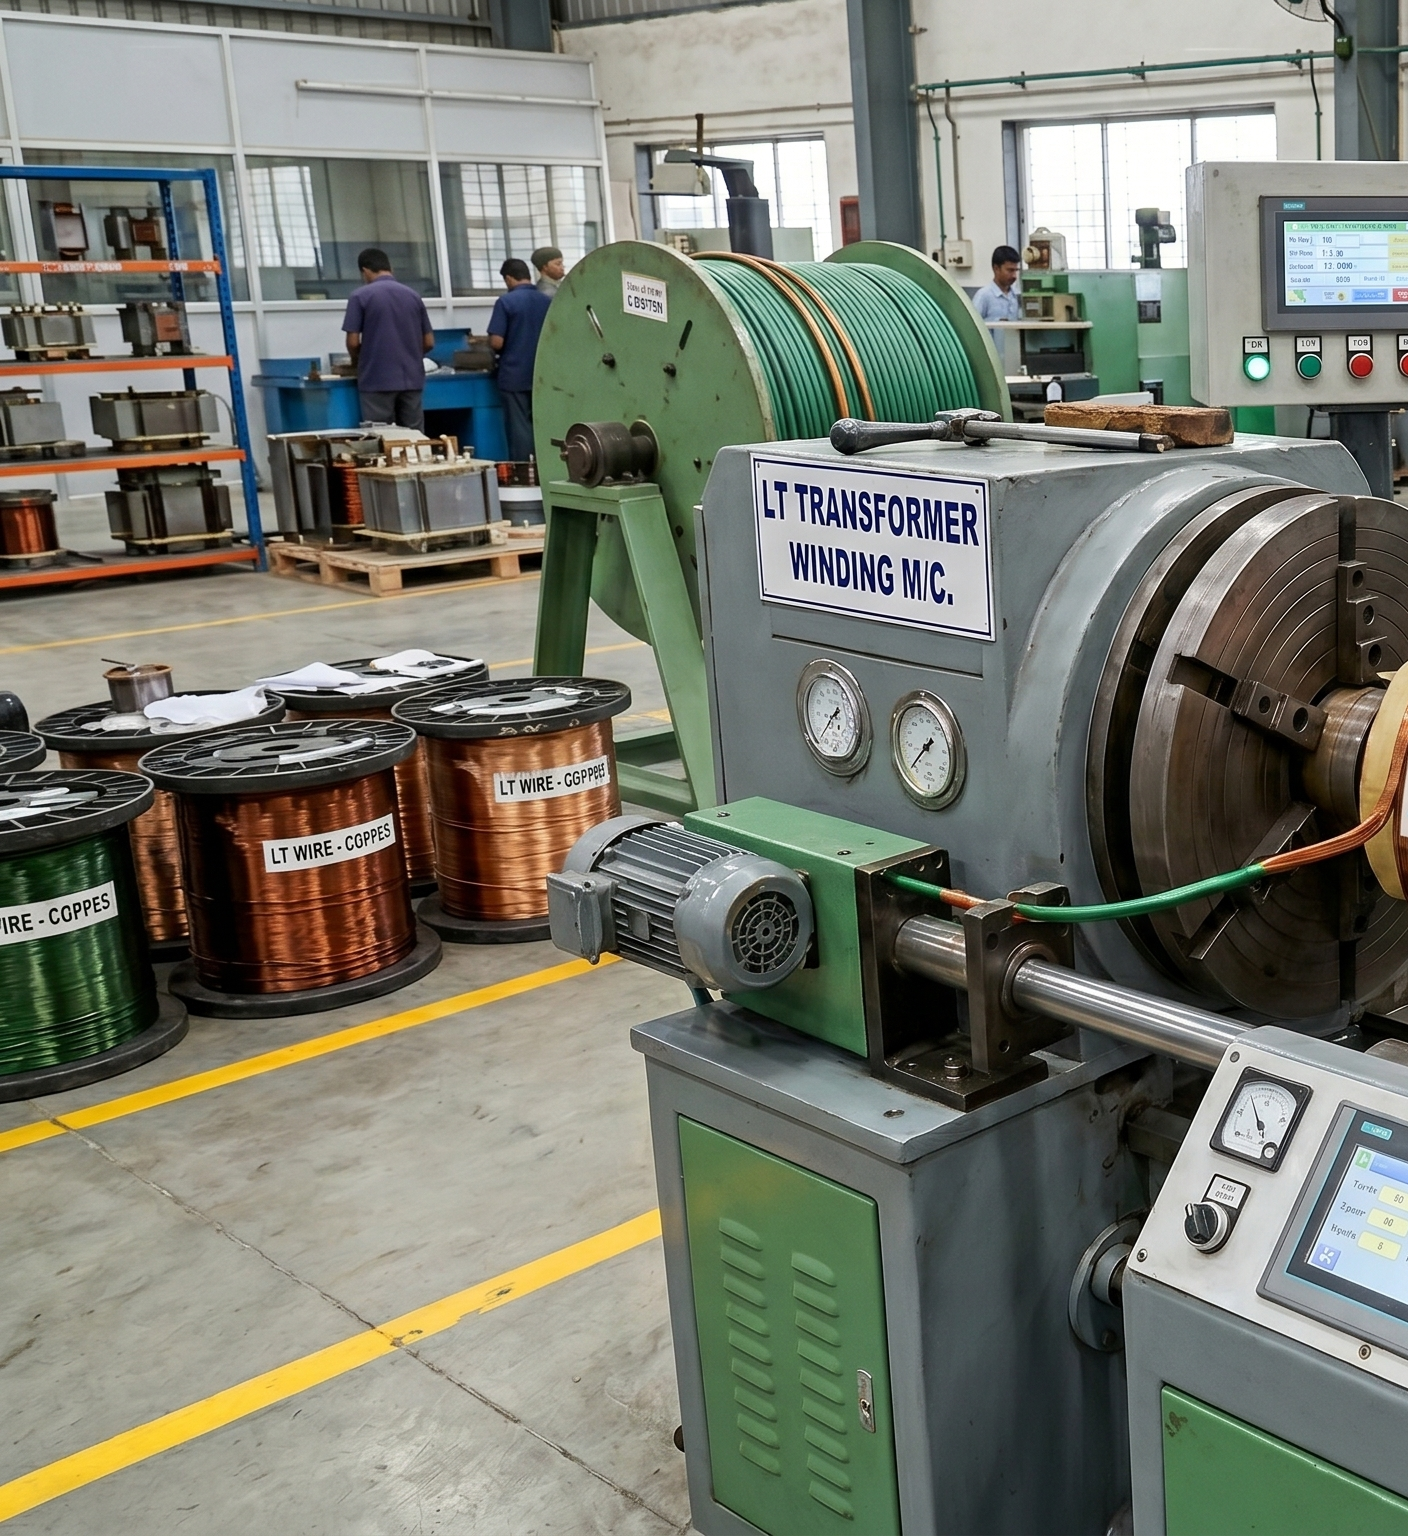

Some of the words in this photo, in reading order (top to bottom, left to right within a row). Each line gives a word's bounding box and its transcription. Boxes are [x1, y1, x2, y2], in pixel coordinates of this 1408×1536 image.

[762, 479, 788, 520] LT
[794, 482, 980, 546] TRANSFORMER
[789, 541, 894, 596] WINDING
[901, 557, 954, 606] M/C.
[499, 780, 516, 796] LT
[520, 775, 555, 795] WIRE
[271, 847, 288, 864] LT
[293, 840, 334, 861] WIRE
[0, 912, 34, 936] IRE
